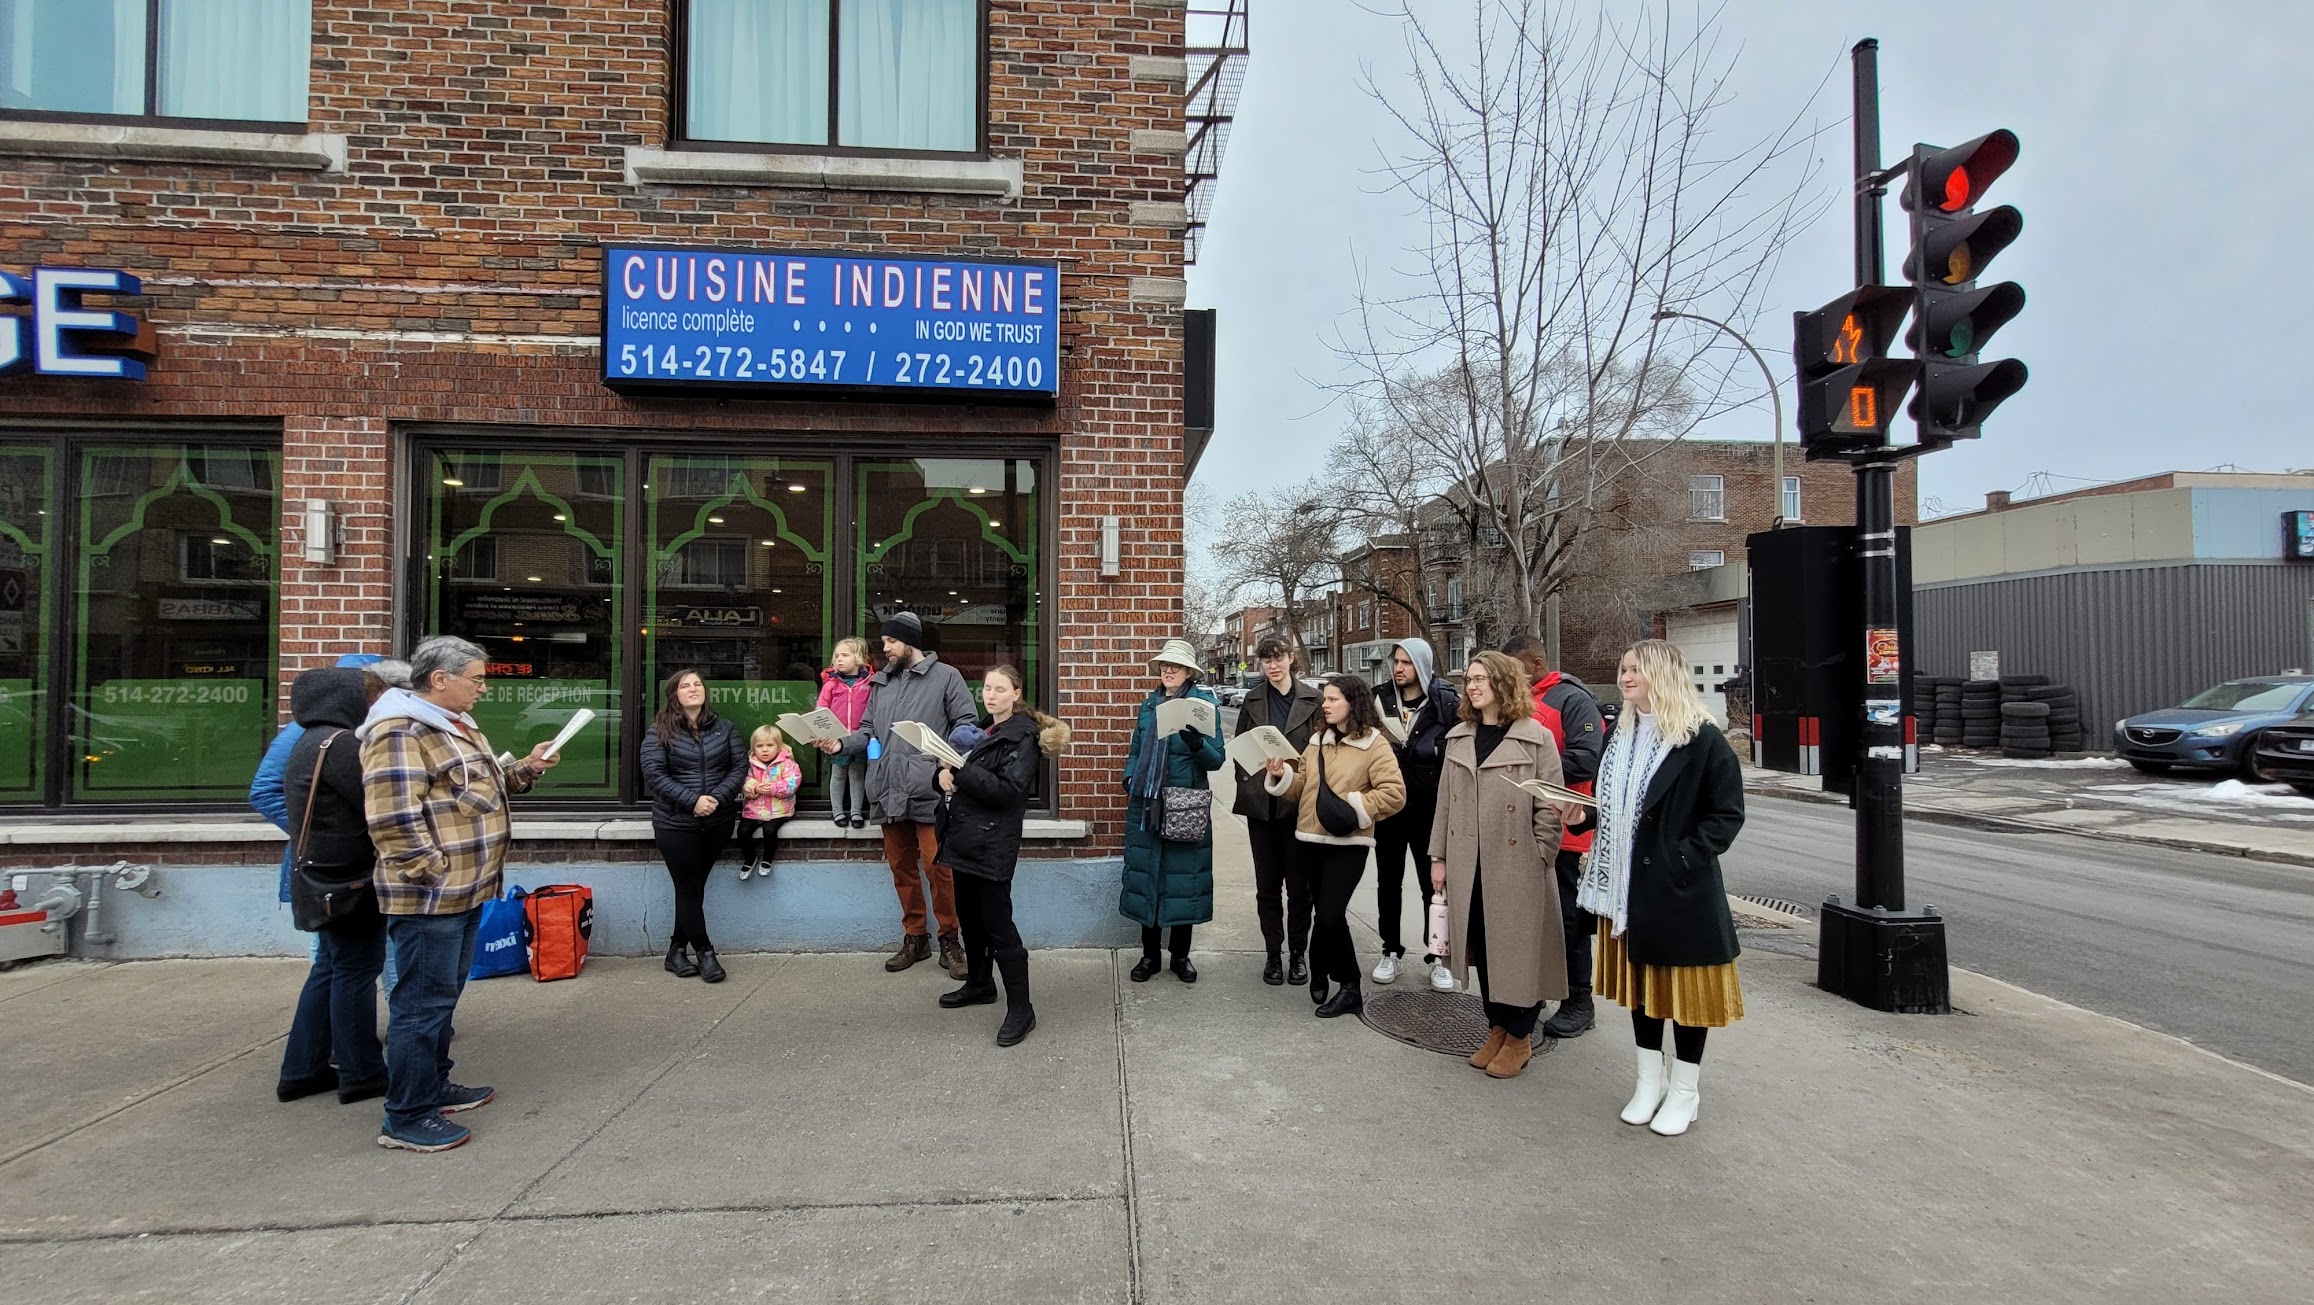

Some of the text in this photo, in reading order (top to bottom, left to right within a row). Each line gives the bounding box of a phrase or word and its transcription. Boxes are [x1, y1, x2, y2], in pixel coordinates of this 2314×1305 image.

[623, 255, 1044, 314] CUISINE INDIENNE
[621, 305, 755, 337] licence complète
[915, 320, 1043, 344] IN GOD WE TRUST
[620, 343, 847, 380] 514-272-5847
[895, 351, 1043, 388] 272-2400
[1851, 386, 1876, 428] 0
[104, 685, 249, 704] 514-272-2400
[498, 686, 513, 702] DE
[517, 682, 591, 702] RÉCEPTION
[709, 687, 790, 704] RTY HALL
